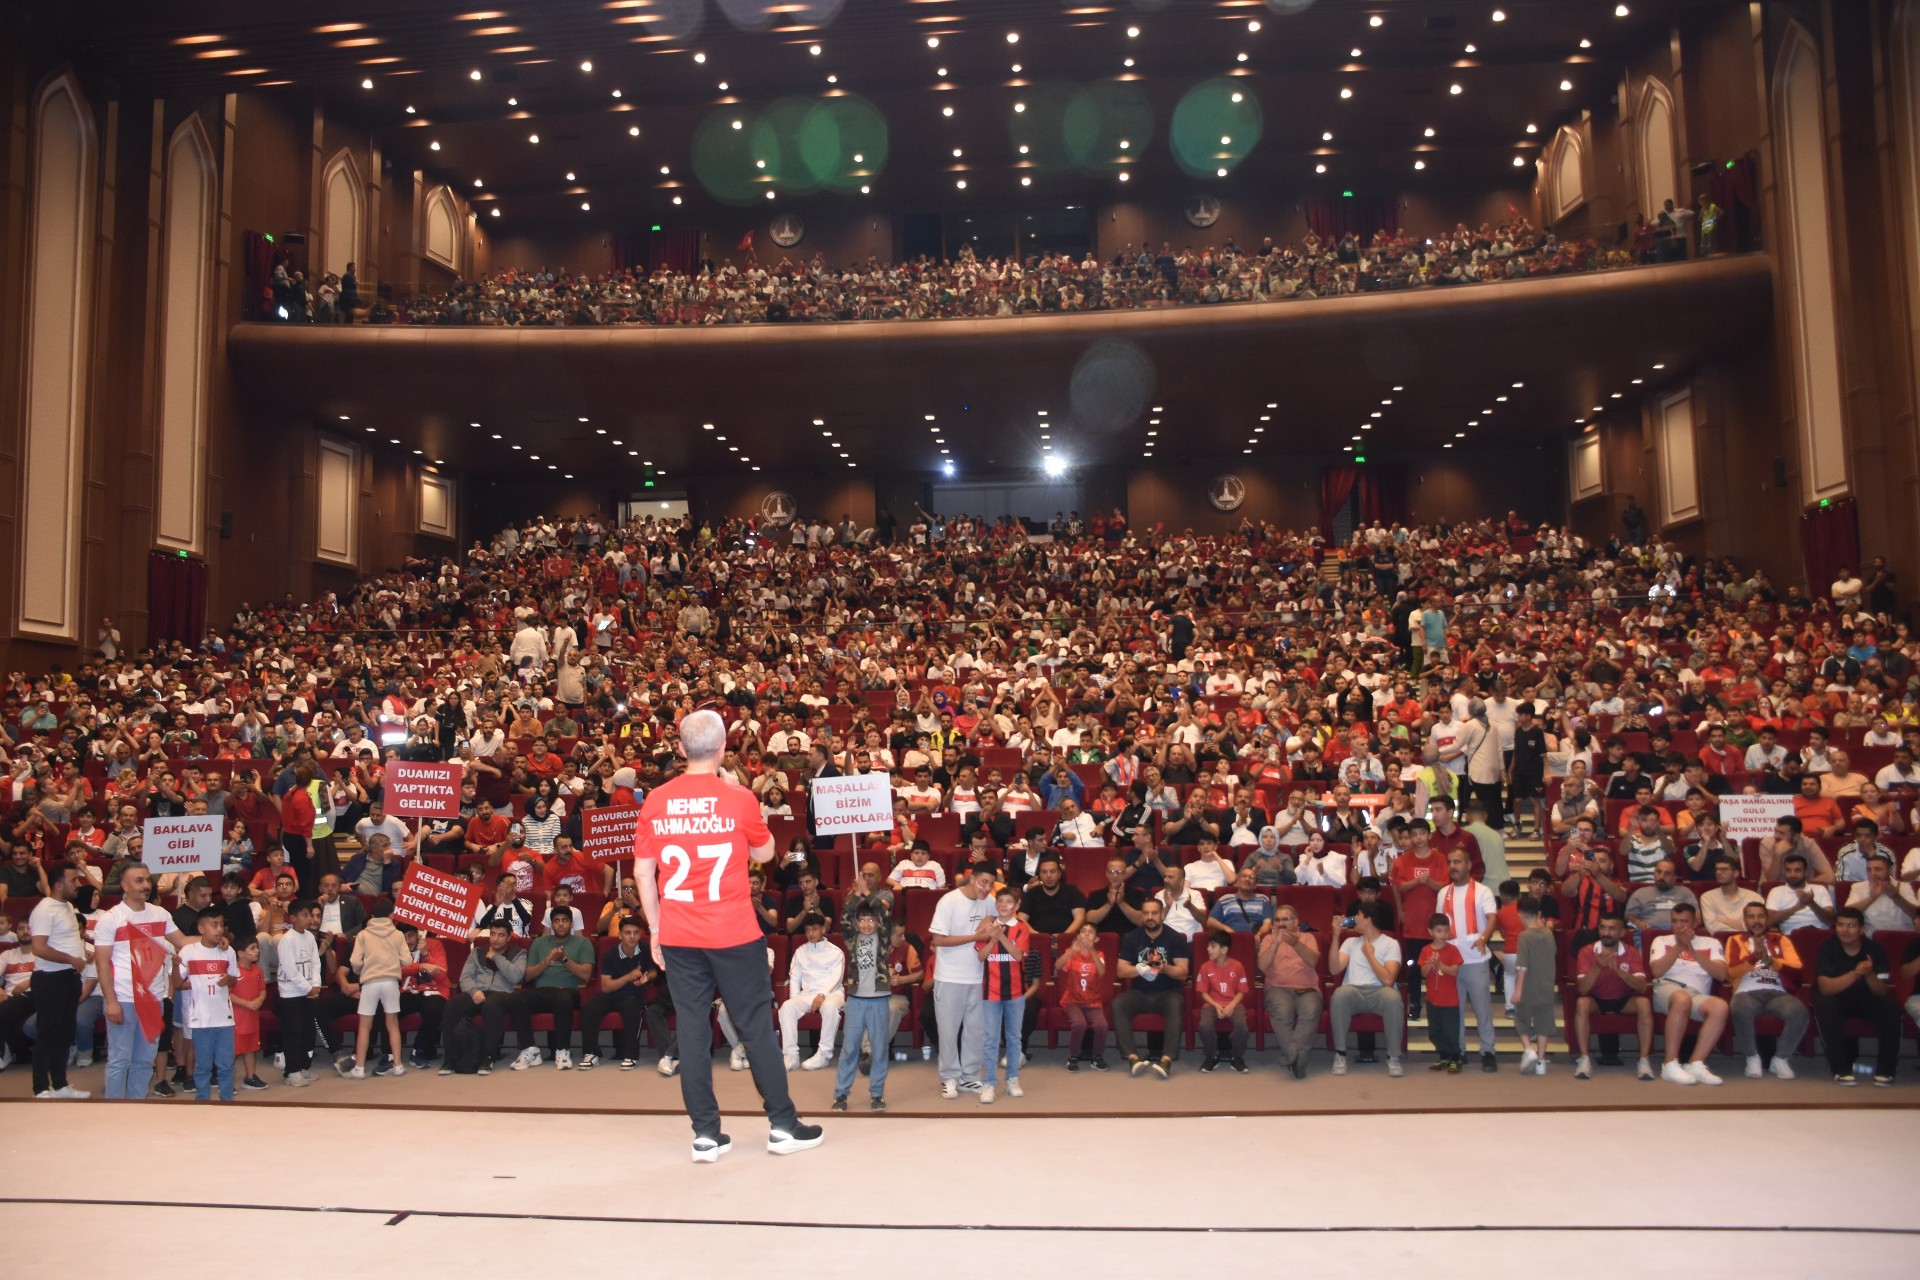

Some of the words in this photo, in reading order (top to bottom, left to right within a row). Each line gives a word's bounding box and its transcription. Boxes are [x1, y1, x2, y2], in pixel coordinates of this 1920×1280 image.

[397, 768, 451, 780] DUAMIZI
[393, 783, 454, 795] YAPTIKTA
[399, 798, 446, 810] GELDİK
[667, 797, 718, 815] MEHMET
[835, 796, 872, 809] BİZİM
[591, 809, 641, 823] GAVURGAY
[814, 810, 893, 828] ÇOCUKLARA
[153, 823, 214, 835] BAKLAVA
[651, 813, 736, 836] TAHMAZOĞLU
[1726, 825, 1750, 833] ÜNYA
[167, 837, 195, 850] GİBİ
[583, 833, 637, 848] AVUSTRALY
[159, 854, 200, 865] TAKIM
[591, 845, 635, 860] ÇATLATTI
[660, 841, 733, 903] 27
[416, 870, 468, 896] KELLENİN
[408, 882, 434, 898] KEFİ
[435, 892, 467, 910] GELDİ
[393, 905, 426, 924] KEYFİ
[401, 893, 469, 925] TÜRKİYE'NİN
[207, 984, 216, 996] 11
